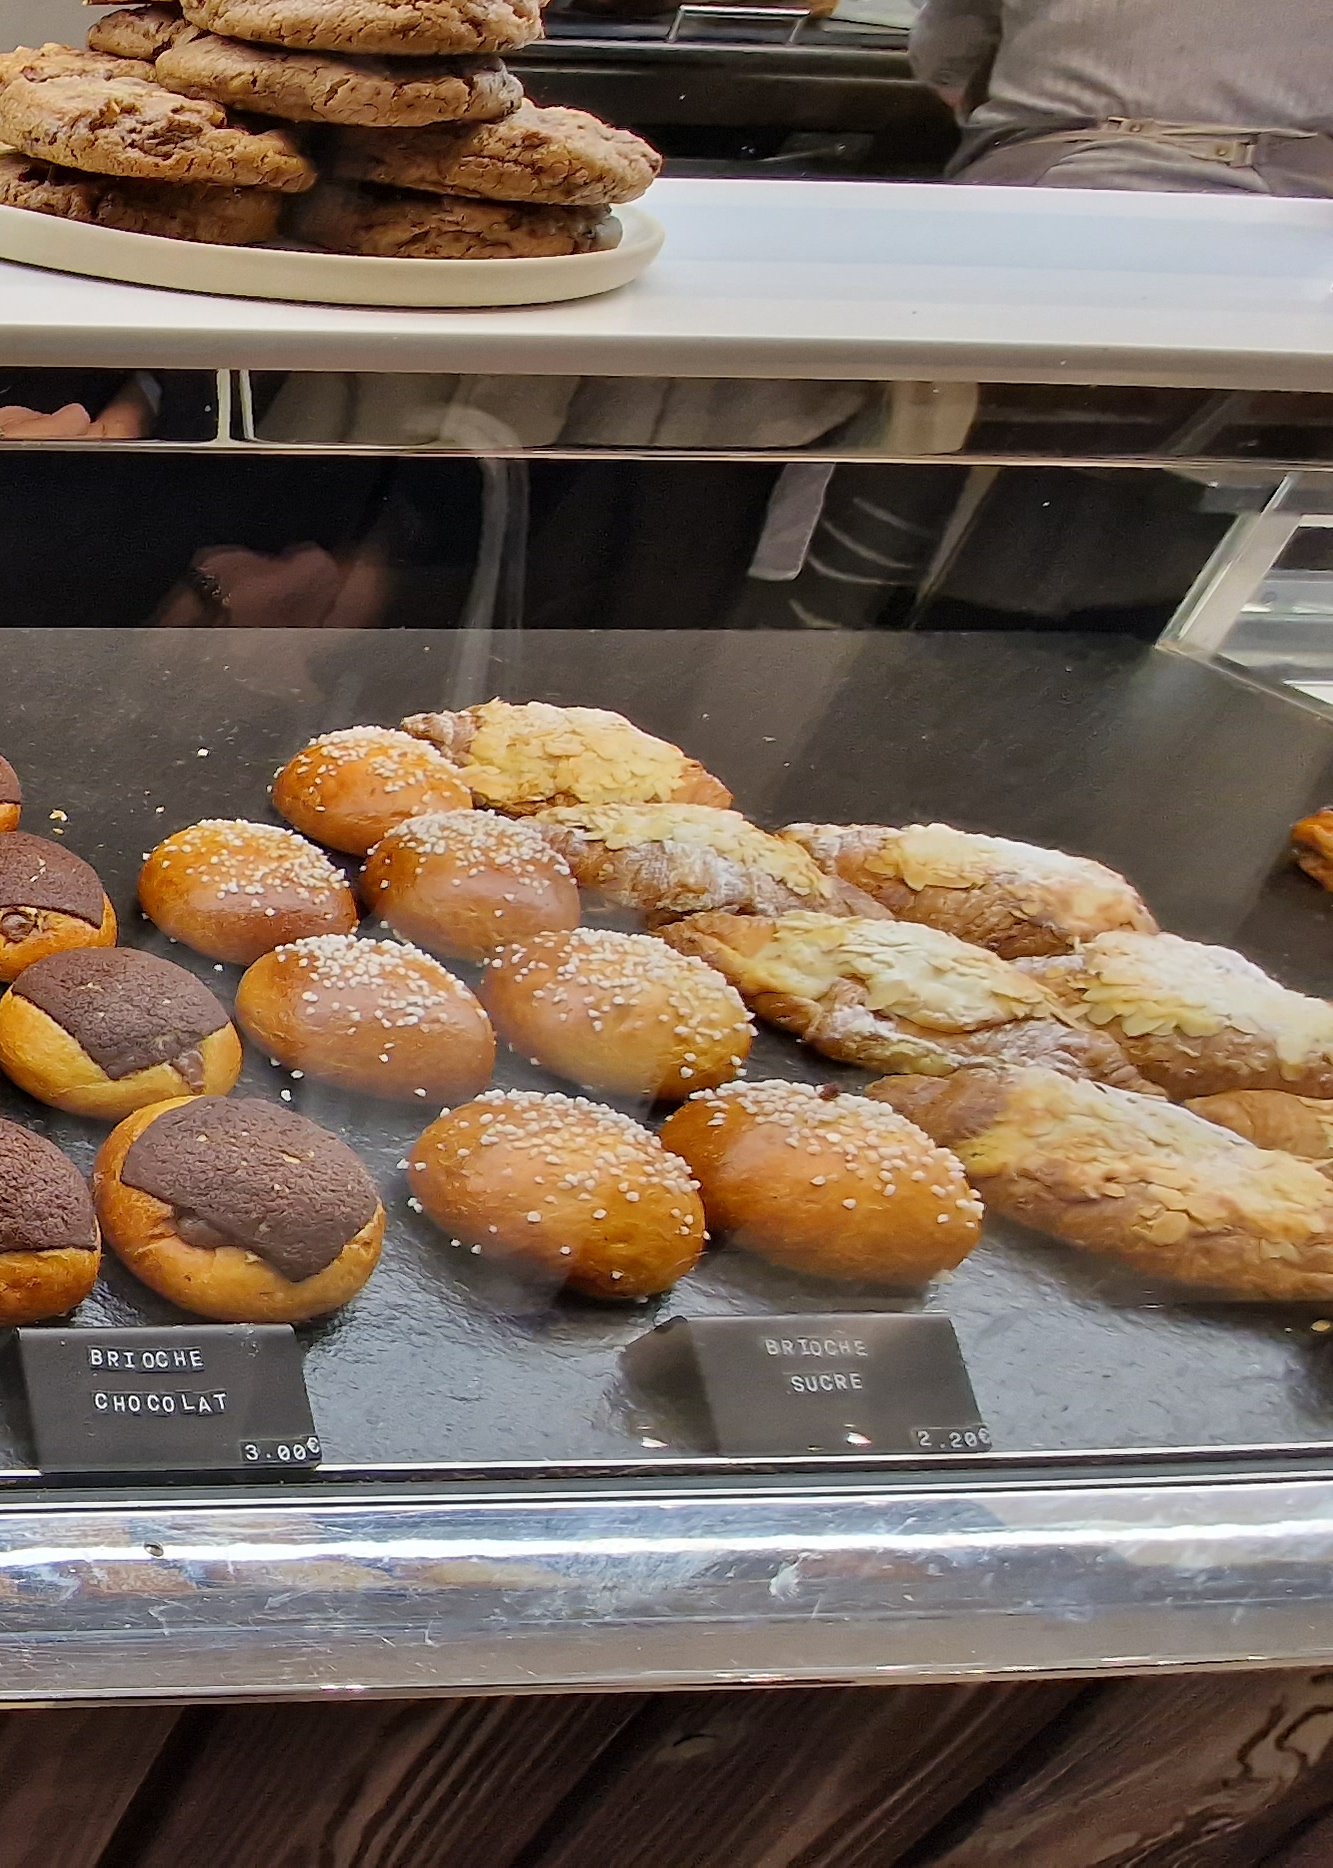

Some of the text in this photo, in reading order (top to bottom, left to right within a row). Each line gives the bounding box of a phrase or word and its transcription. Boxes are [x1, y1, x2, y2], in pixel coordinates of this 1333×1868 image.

[764, 1338, 868, 1357] BRIOCHE
[90, 1349, 204, 1369] BRIOCHE
[789, 1373, 864, 1393] SUCRE
[94, 1392, 227, 1413] CHOCOLAT
[245, 1437, 320, 1460] 3.00€
